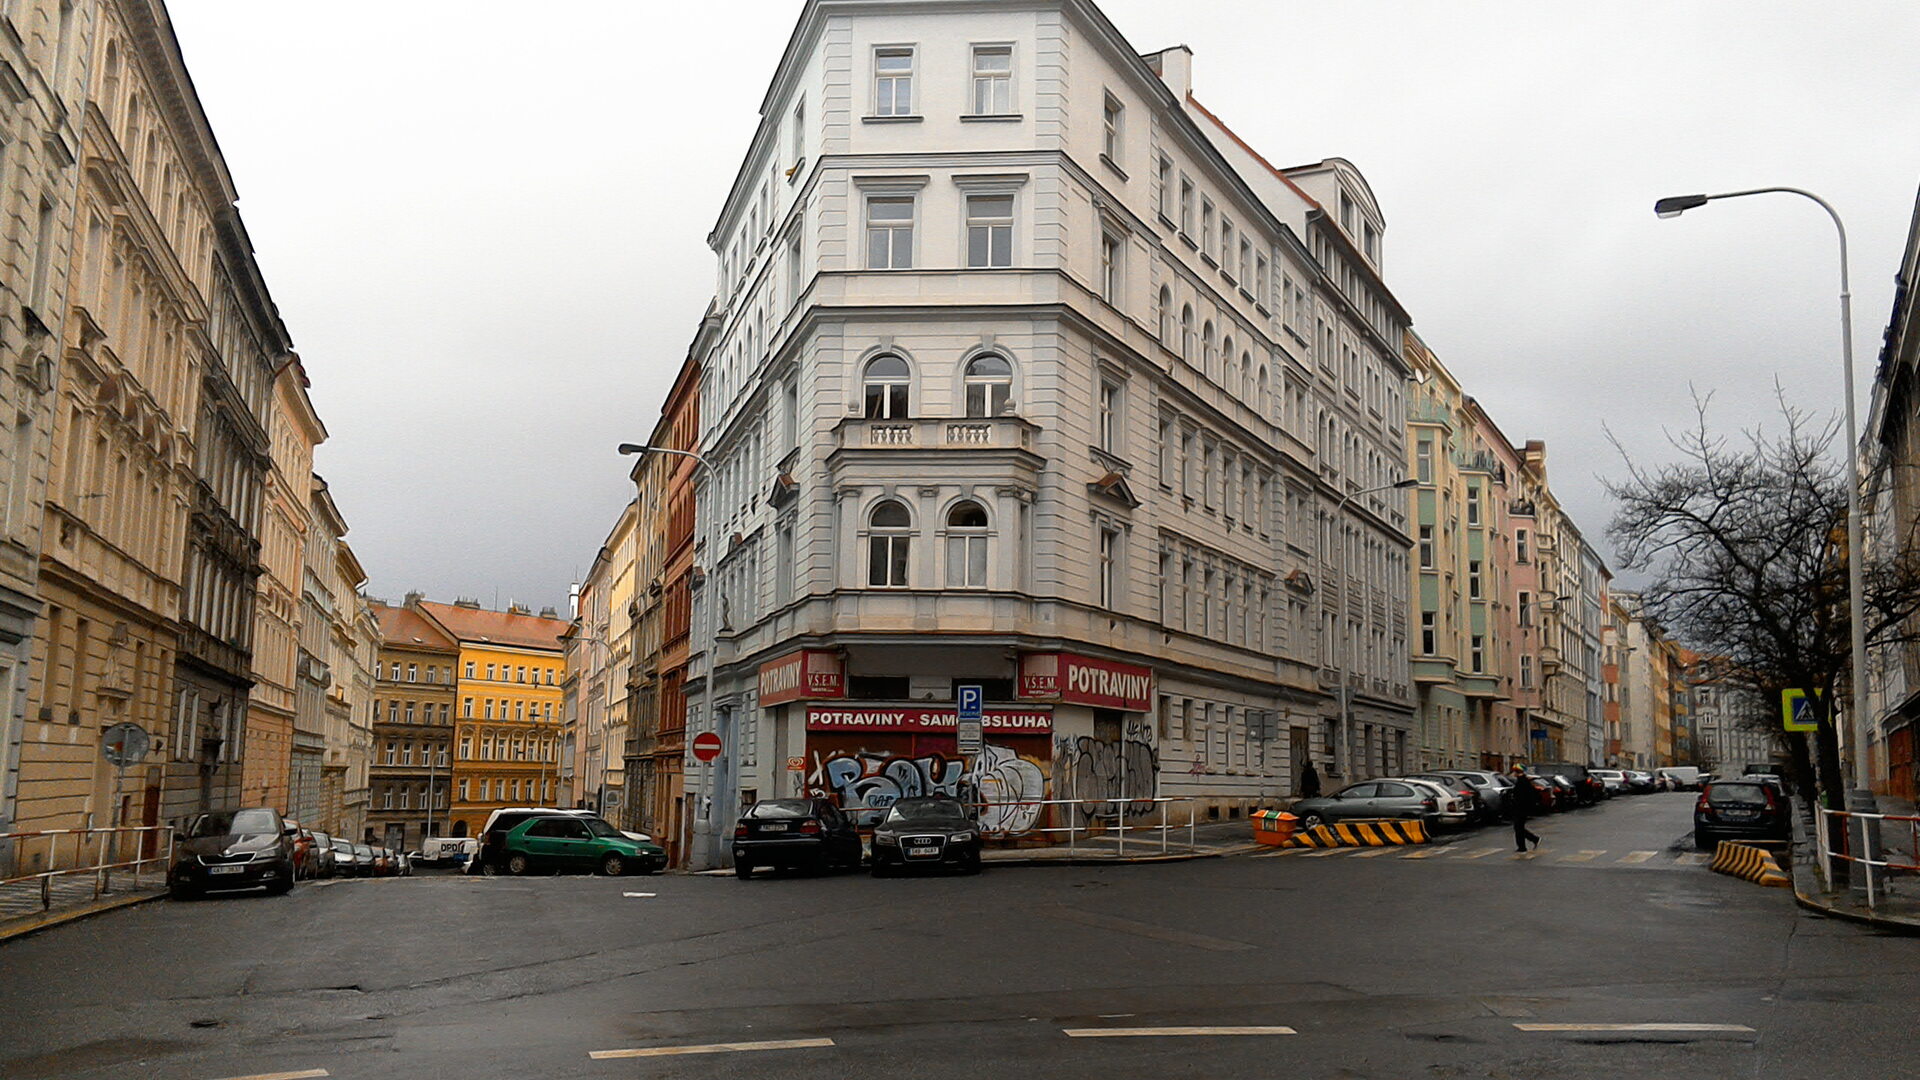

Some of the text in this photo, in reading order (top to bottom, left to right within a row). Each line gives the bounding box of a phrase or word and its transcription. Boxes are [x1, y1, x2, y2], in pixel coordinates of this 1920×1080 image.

[760, 660, 802, 696] POTRAVINY
[1068, 664, 1150, 700] POTRAVINY
[963, 690, 977, 709] P
[810, 712, 904, 725] POTRAVINY
[919, 714, 1048, 728] SAMBSLUHA
